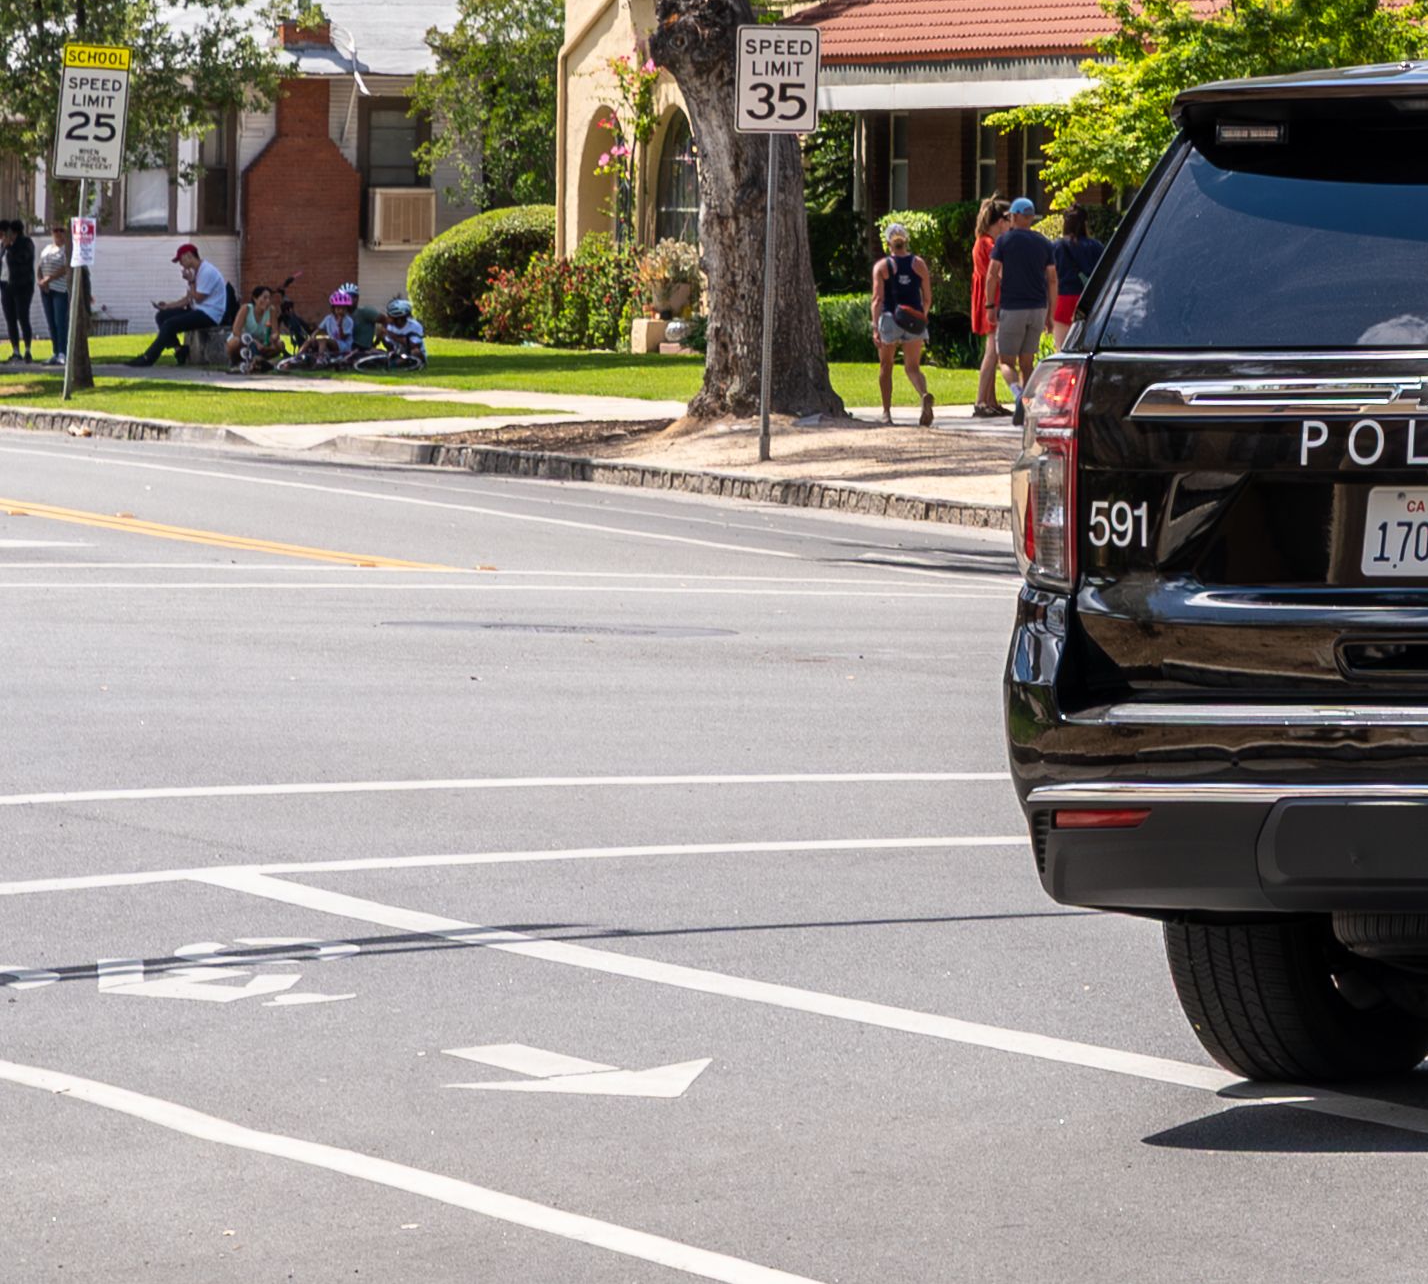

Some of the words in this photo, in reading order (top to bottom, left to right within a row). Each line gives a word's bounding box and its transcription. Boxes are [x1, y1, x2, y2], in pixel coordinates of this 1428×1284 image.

[745, 39, 813, 56] SPEED
[68, 50, 126, 66] SCHOOL
[752, 60, 804, 77] LIMIT
[68, 77, 122, 92] SPEED
[72, 94, 115, 108] LIMIT
[745, 82, 807, 121] 35
[65, 111, 116, 142] 25
[1406, 499, 1426, 513] CA
[1088, 500, 1150, 548] 591
